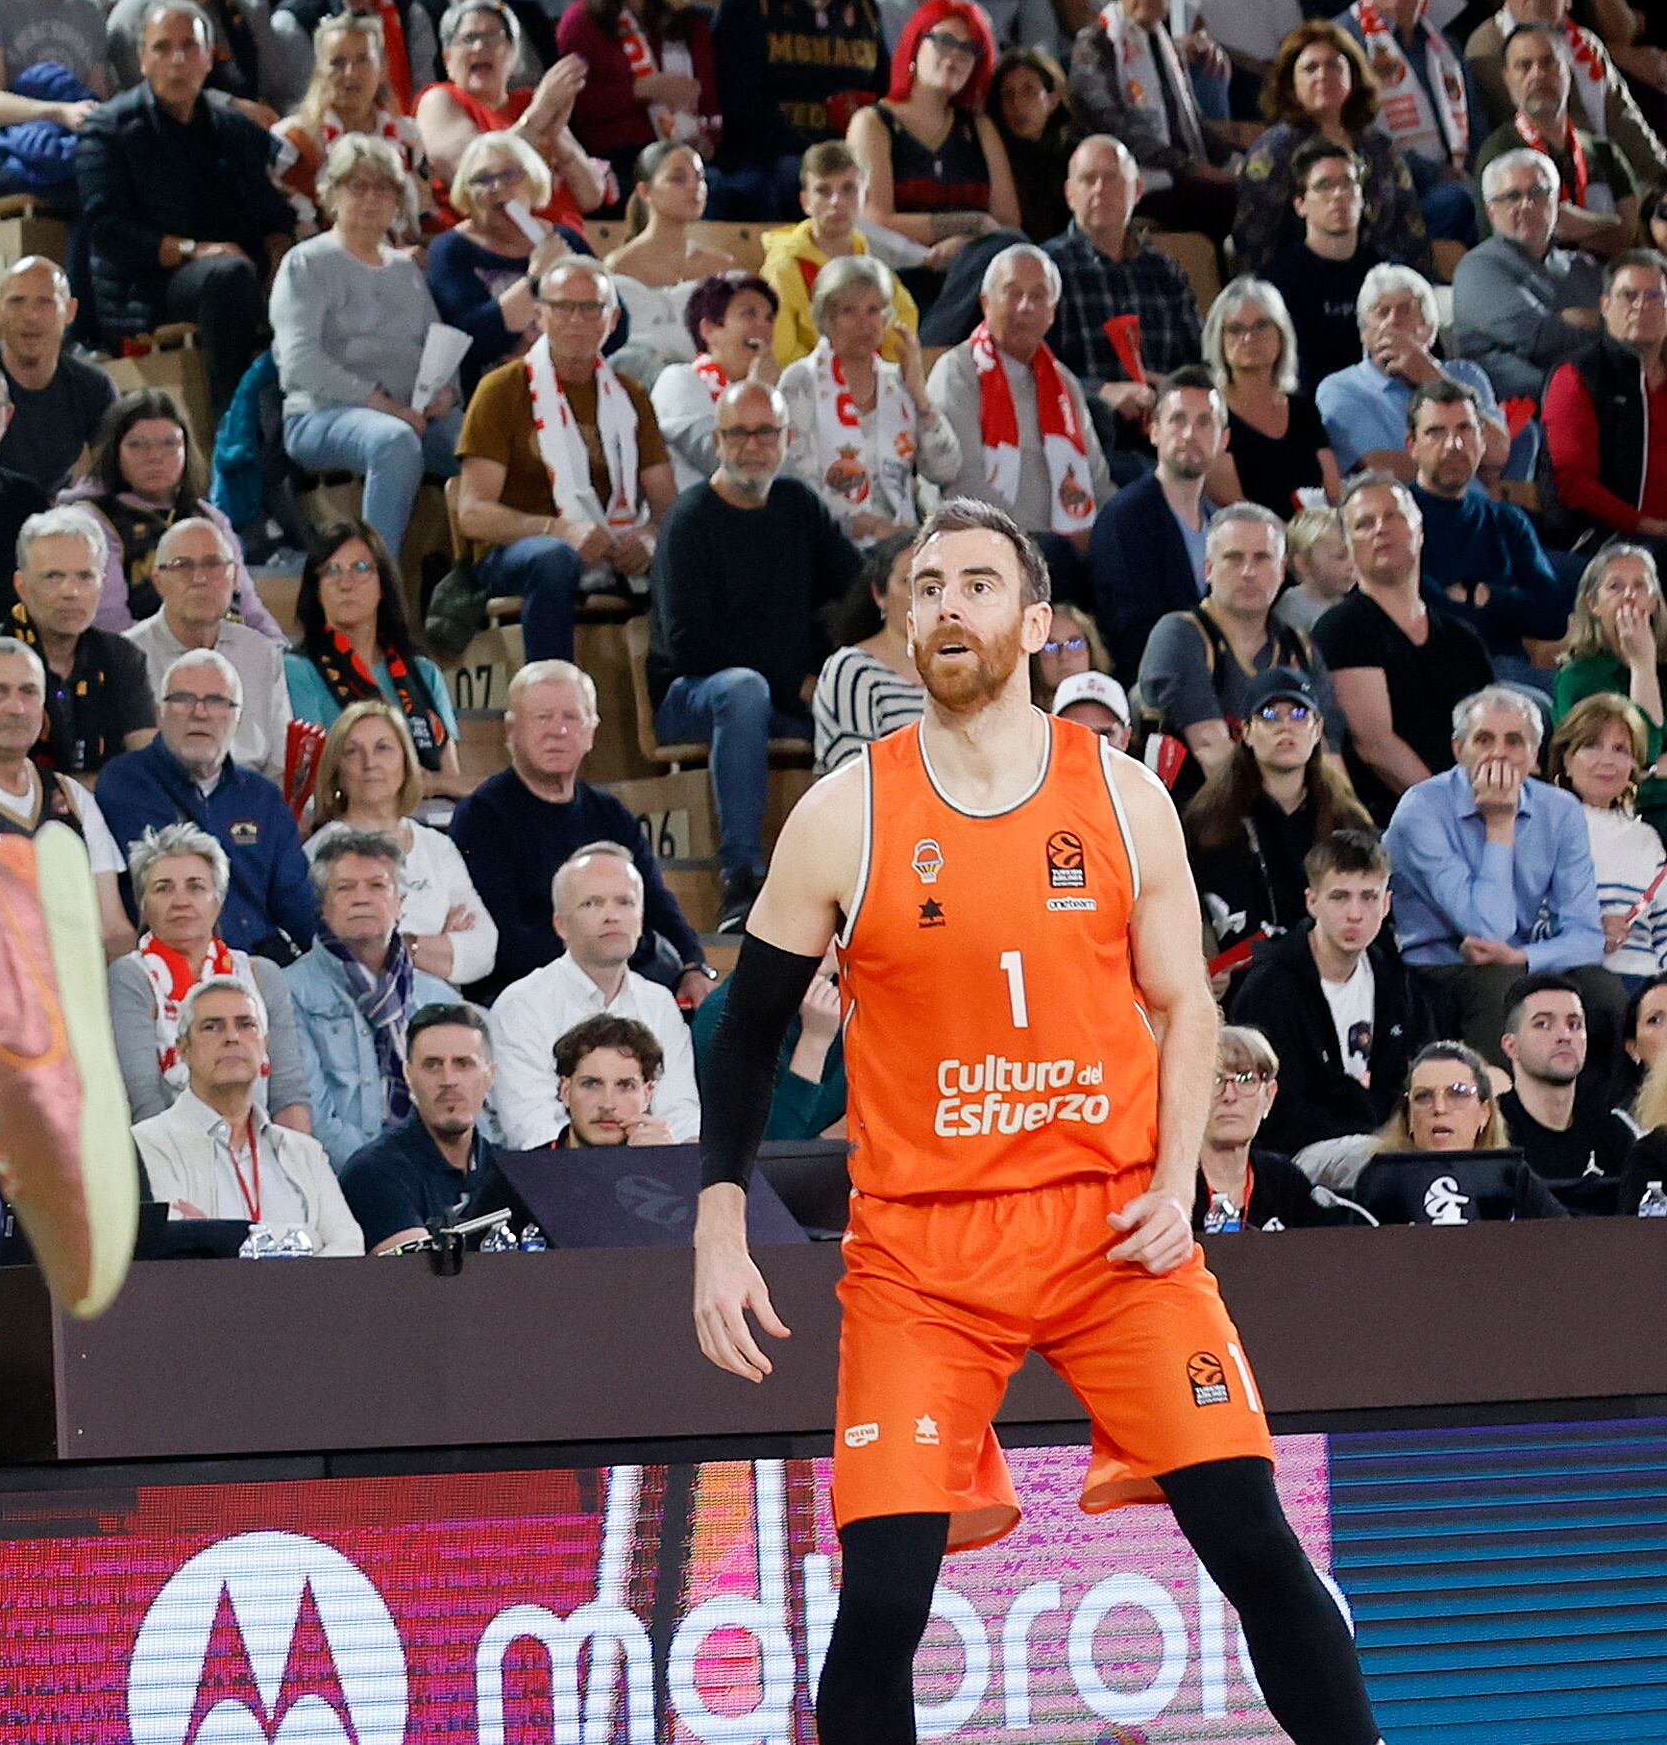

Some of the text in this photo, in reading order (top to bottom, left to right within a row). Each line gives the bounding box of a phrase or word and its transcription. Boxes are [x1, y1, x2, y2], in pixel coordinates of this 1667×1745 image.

[1000, 950, 1029, 1028] 1
[1077, 1061, 1103, 1086] del
[934, 1093, 1110, 1137] Esfuerzo
